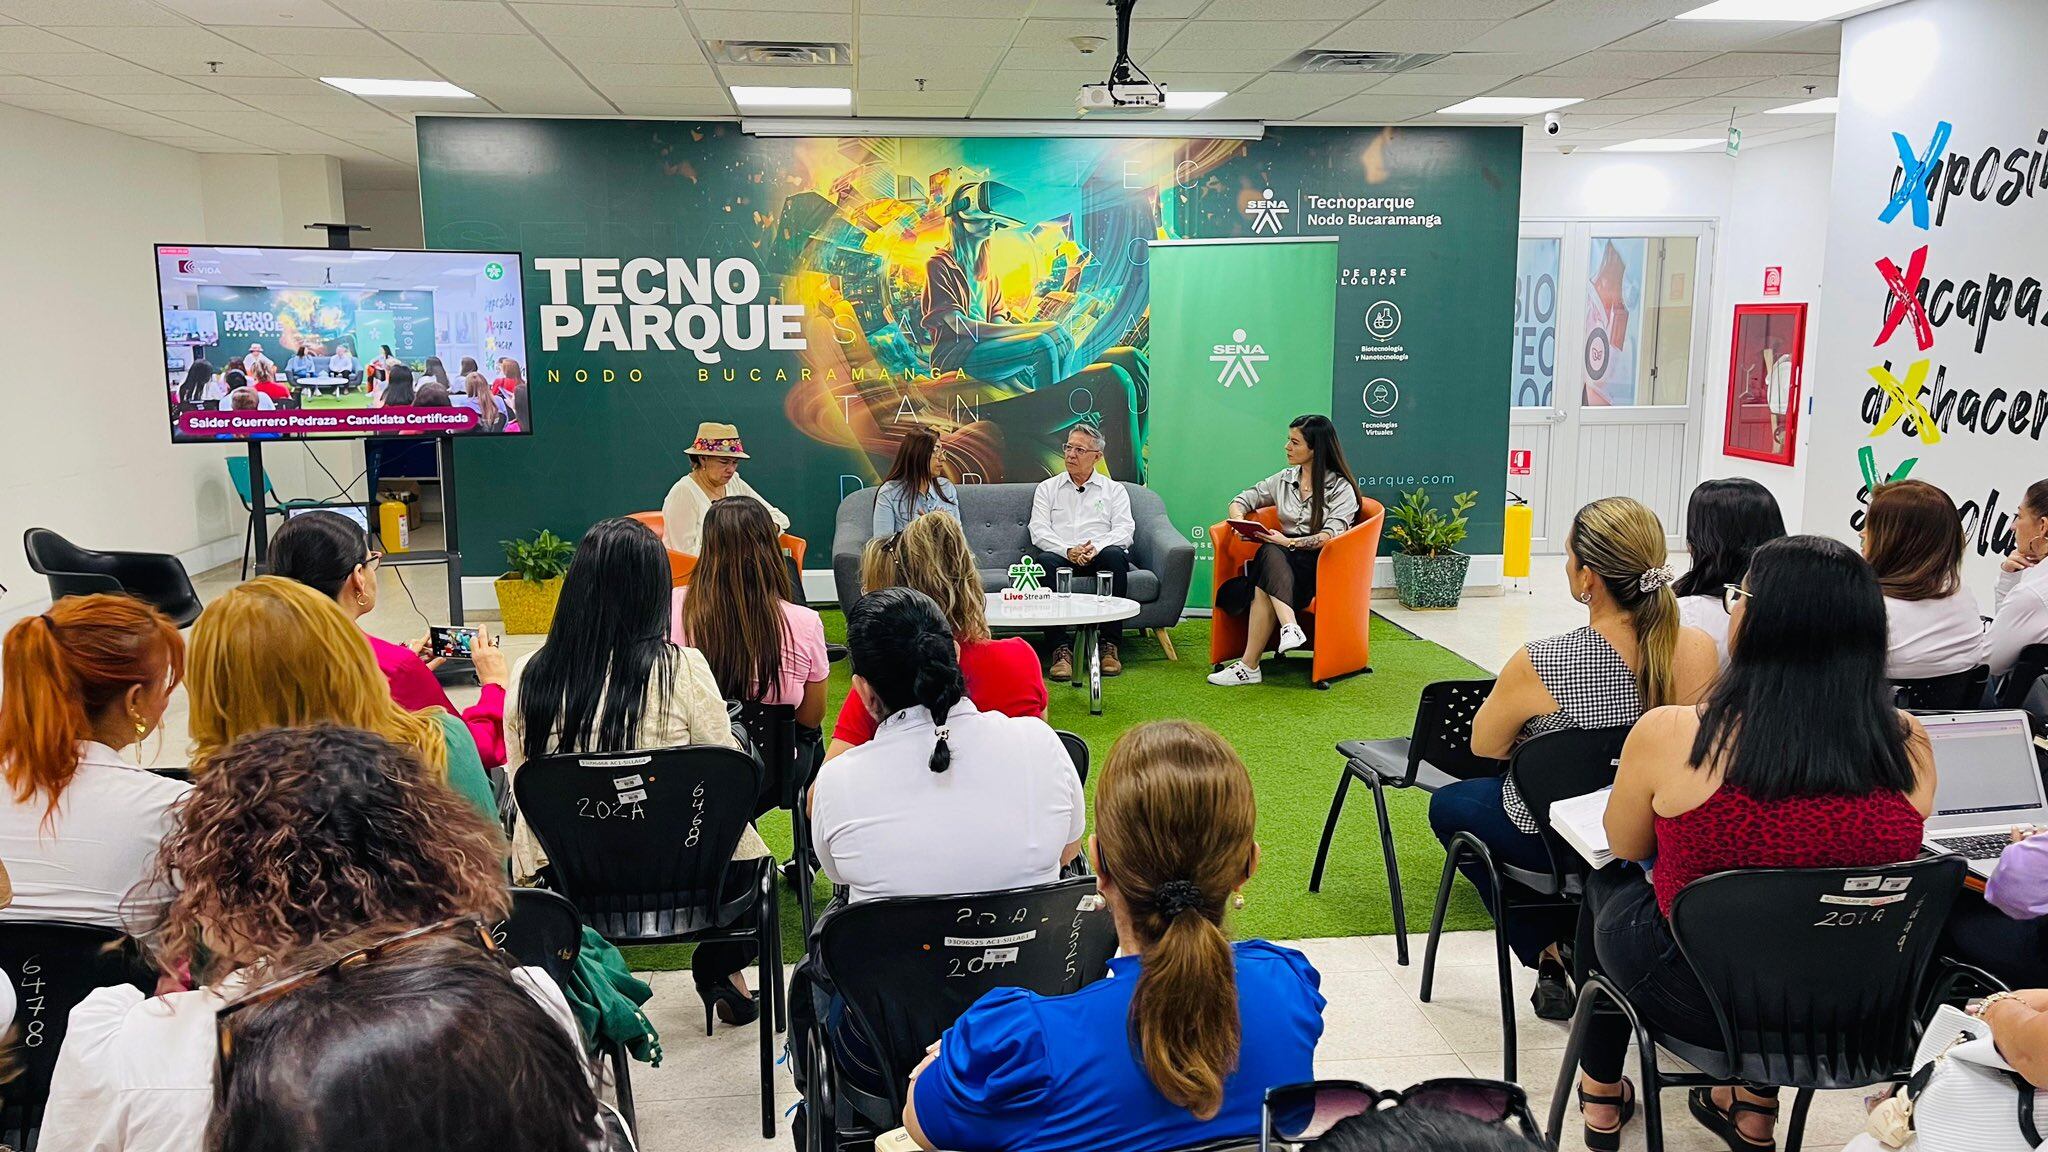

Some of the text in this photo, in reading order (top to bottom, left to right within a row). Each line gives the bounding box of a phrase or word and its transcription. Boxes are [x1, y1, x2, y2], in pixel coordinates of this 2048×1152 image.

[1247, 200, 1289, 209] SENA
[1307, 195, 1415, 212] Tecnoparque
[1307, 213, 1442, 228] Nodo Bucaramanga
[1335, 274, 1396, 286] LÓGICA
[1343, 268, 1407, 277] DE BASE
[535, 257, 760, 305] TECNO
[540, 304, 807, 364] PARQUE
[1213, 344, 1266, 354] SENA
[549, 367, 967, 383] NODO BUCARAMANGA
[232, 417, 288, 427] Guerrero
[289, 415, 338, 426] Pedraza
[346, 413, 405, 426] Candidata
[406, 412, 468, 424] Certificada
[1358, 475, 1455, 487] parque.com
[21, 954, 47, 1048] 6478
